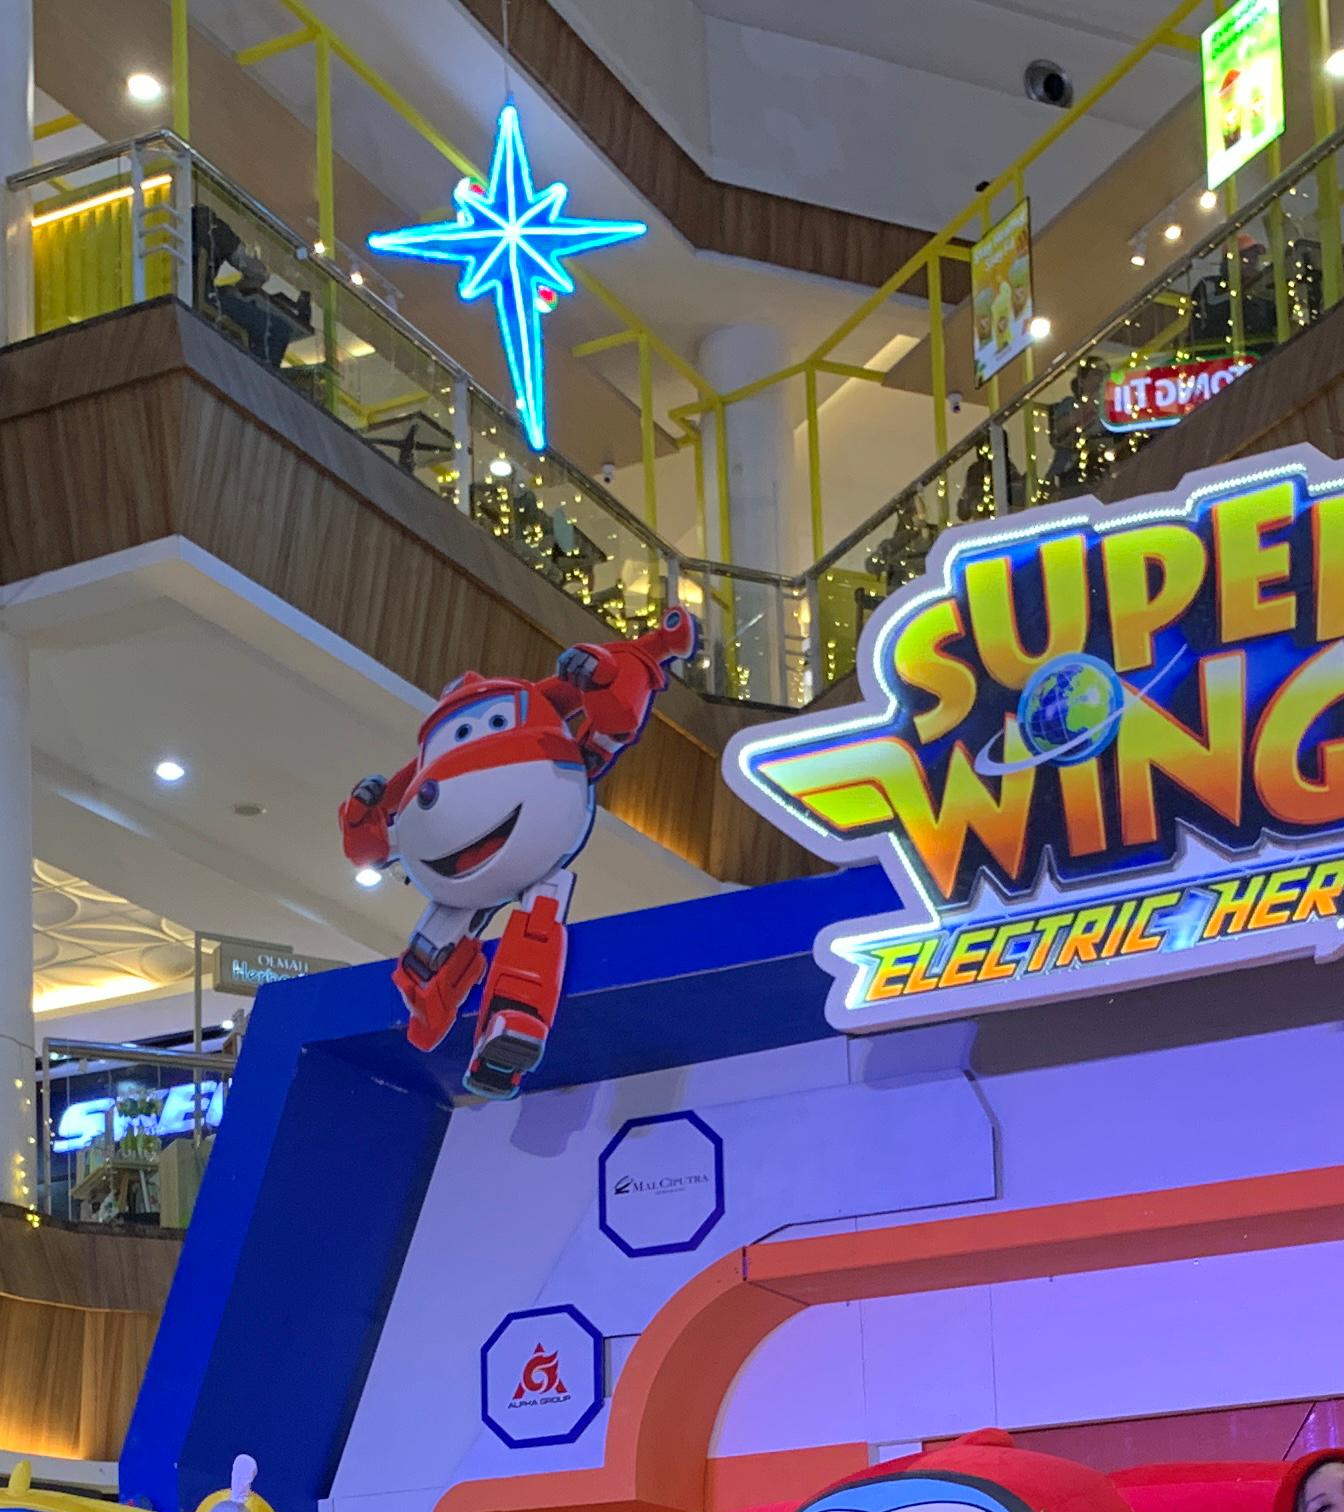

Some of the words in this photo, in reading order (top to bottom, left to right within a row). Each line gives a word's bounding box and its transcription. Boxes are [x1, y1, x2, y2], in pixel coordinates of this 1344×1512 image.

[867, 890, 1183, 1003] ELECTRIC
[508, 1400, 538, 1409] ALPHA
[540, 1395, 571, 1405] GROUP
